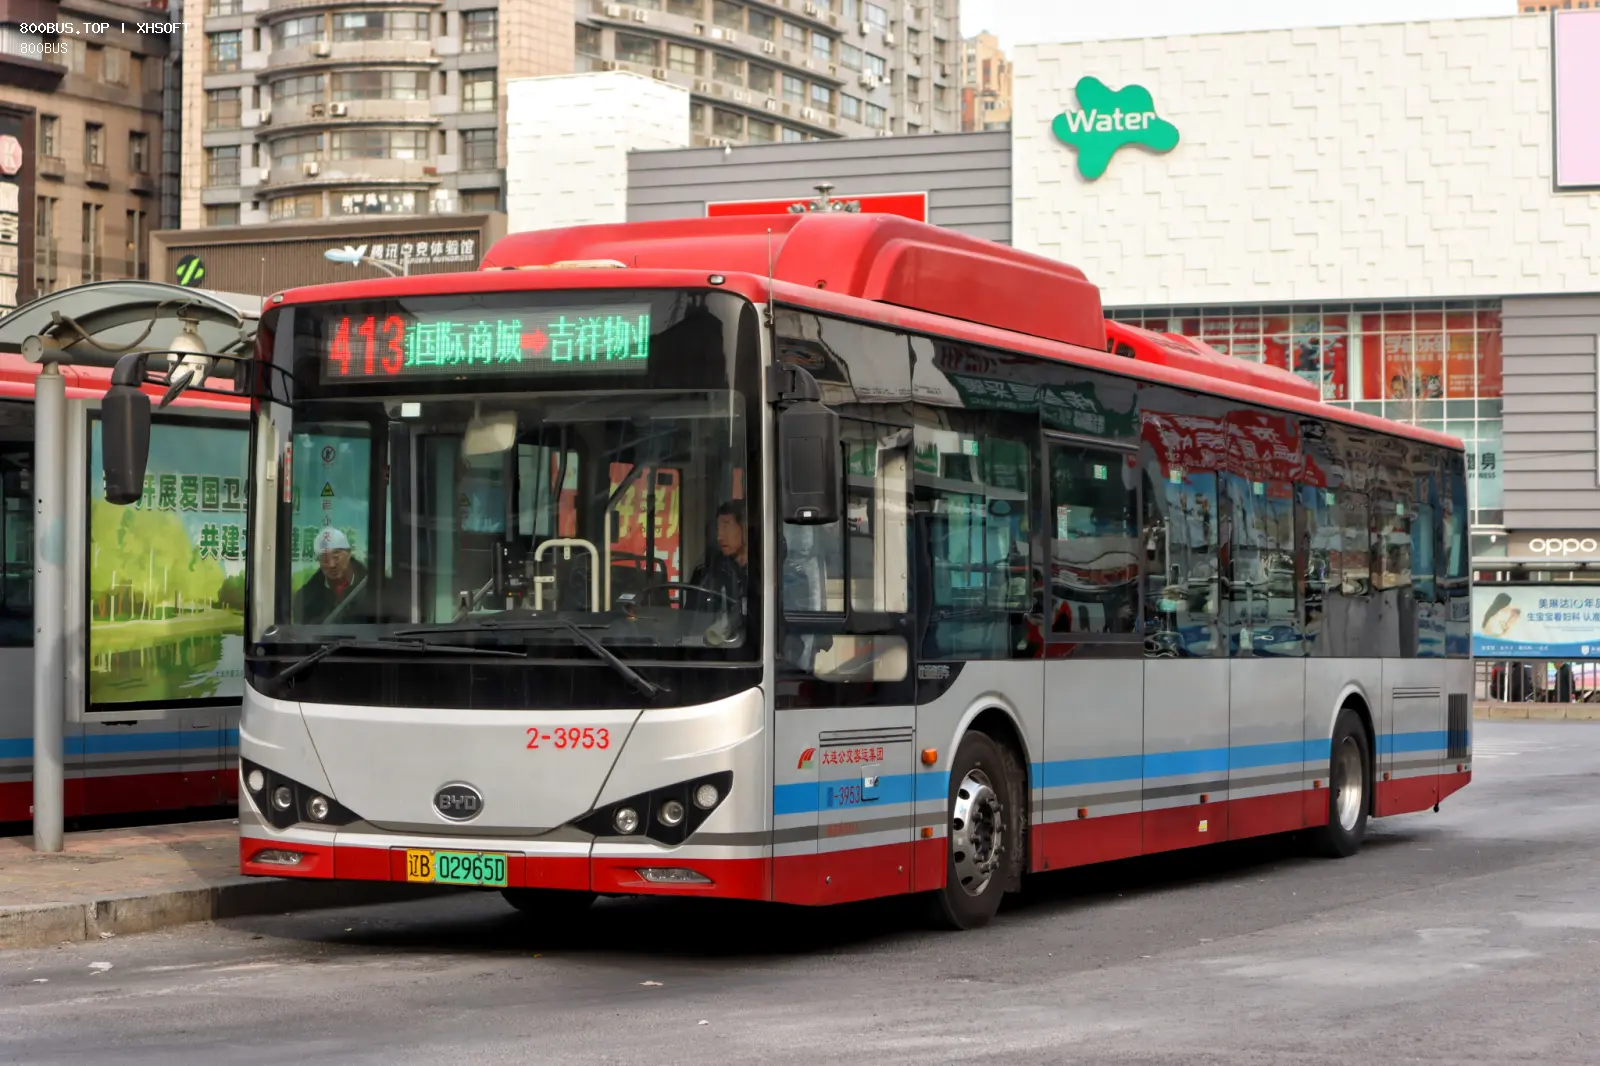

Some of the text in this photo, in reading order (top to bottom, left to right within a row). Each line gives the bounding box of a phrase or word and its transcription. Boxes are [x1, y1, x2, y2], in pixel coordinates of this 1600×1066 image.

[1065, 107, 1156, 133] Water
[329, 315, 404, 376] 413
[134, 473, 247, 512] 开展爱国卫
[526, 727, 610, 750] 2-3953
[438, 794, 477, 811] BYD
[826, 785, 861, 807] -3953
[438, 855, 505, 882] 02965D
